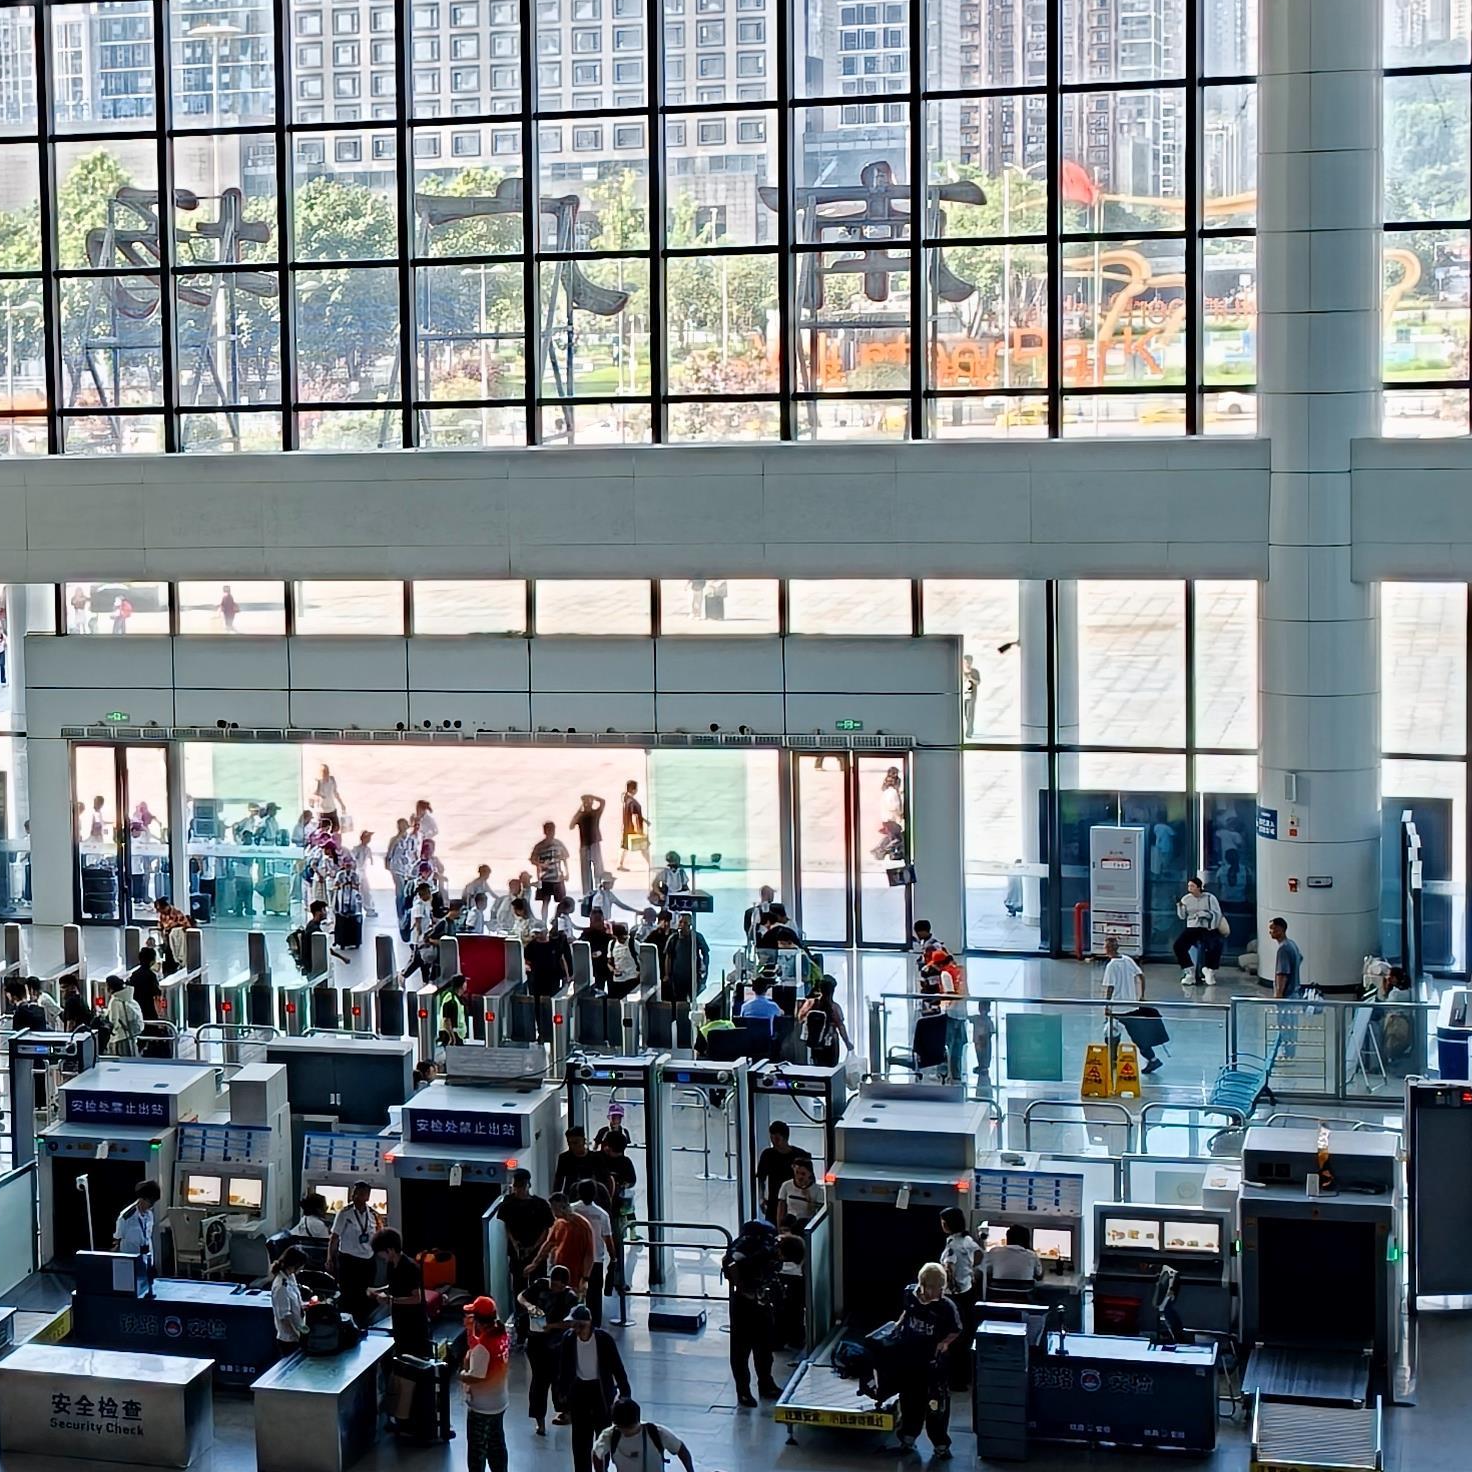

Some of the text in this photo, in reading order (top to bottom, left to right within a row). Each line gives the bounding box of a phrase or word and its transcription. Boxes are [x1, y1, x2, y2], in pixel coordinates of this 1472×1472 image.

[416, 1119, 516, 1137] 安检处禁止出站
[51, 1393, 143, 1421] 安全检查
[50, 1417, 145, 1436] Security Check
